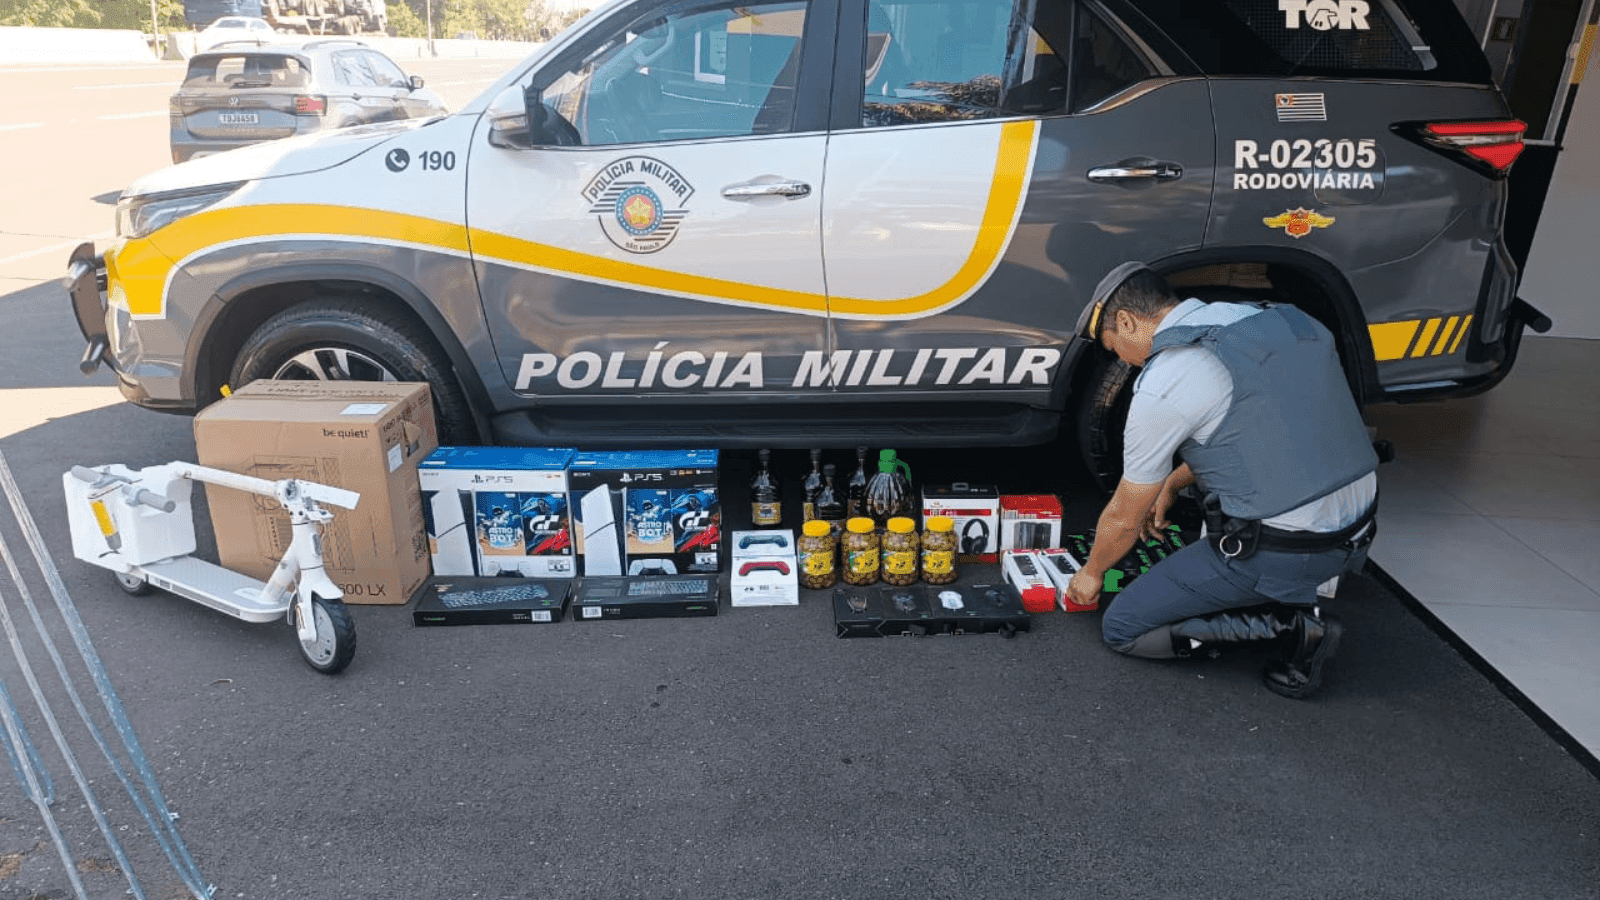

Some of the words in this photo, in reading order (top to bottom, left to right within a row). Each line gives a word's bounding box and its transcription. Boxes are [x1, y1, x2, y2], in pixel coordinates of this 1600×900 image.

[1278, 0, 1370, 31] TOR
[418, 150, 456, 171] 190
[1233, 139, 1377, 169] R-02305
[640, 160, 688, 198] MILITAR
[1233, 168, 1376, 190] RODOVIÁRIA
[514, 341, 764, 390] POLÍCIA
[791, 348, 1061, 388] MILITAR
[323, 428, 337, 437] be
[485, 475, 513, 483] PS5
[634, 473, 663, 481] PS5
[367, 583, 387, 596] LX
